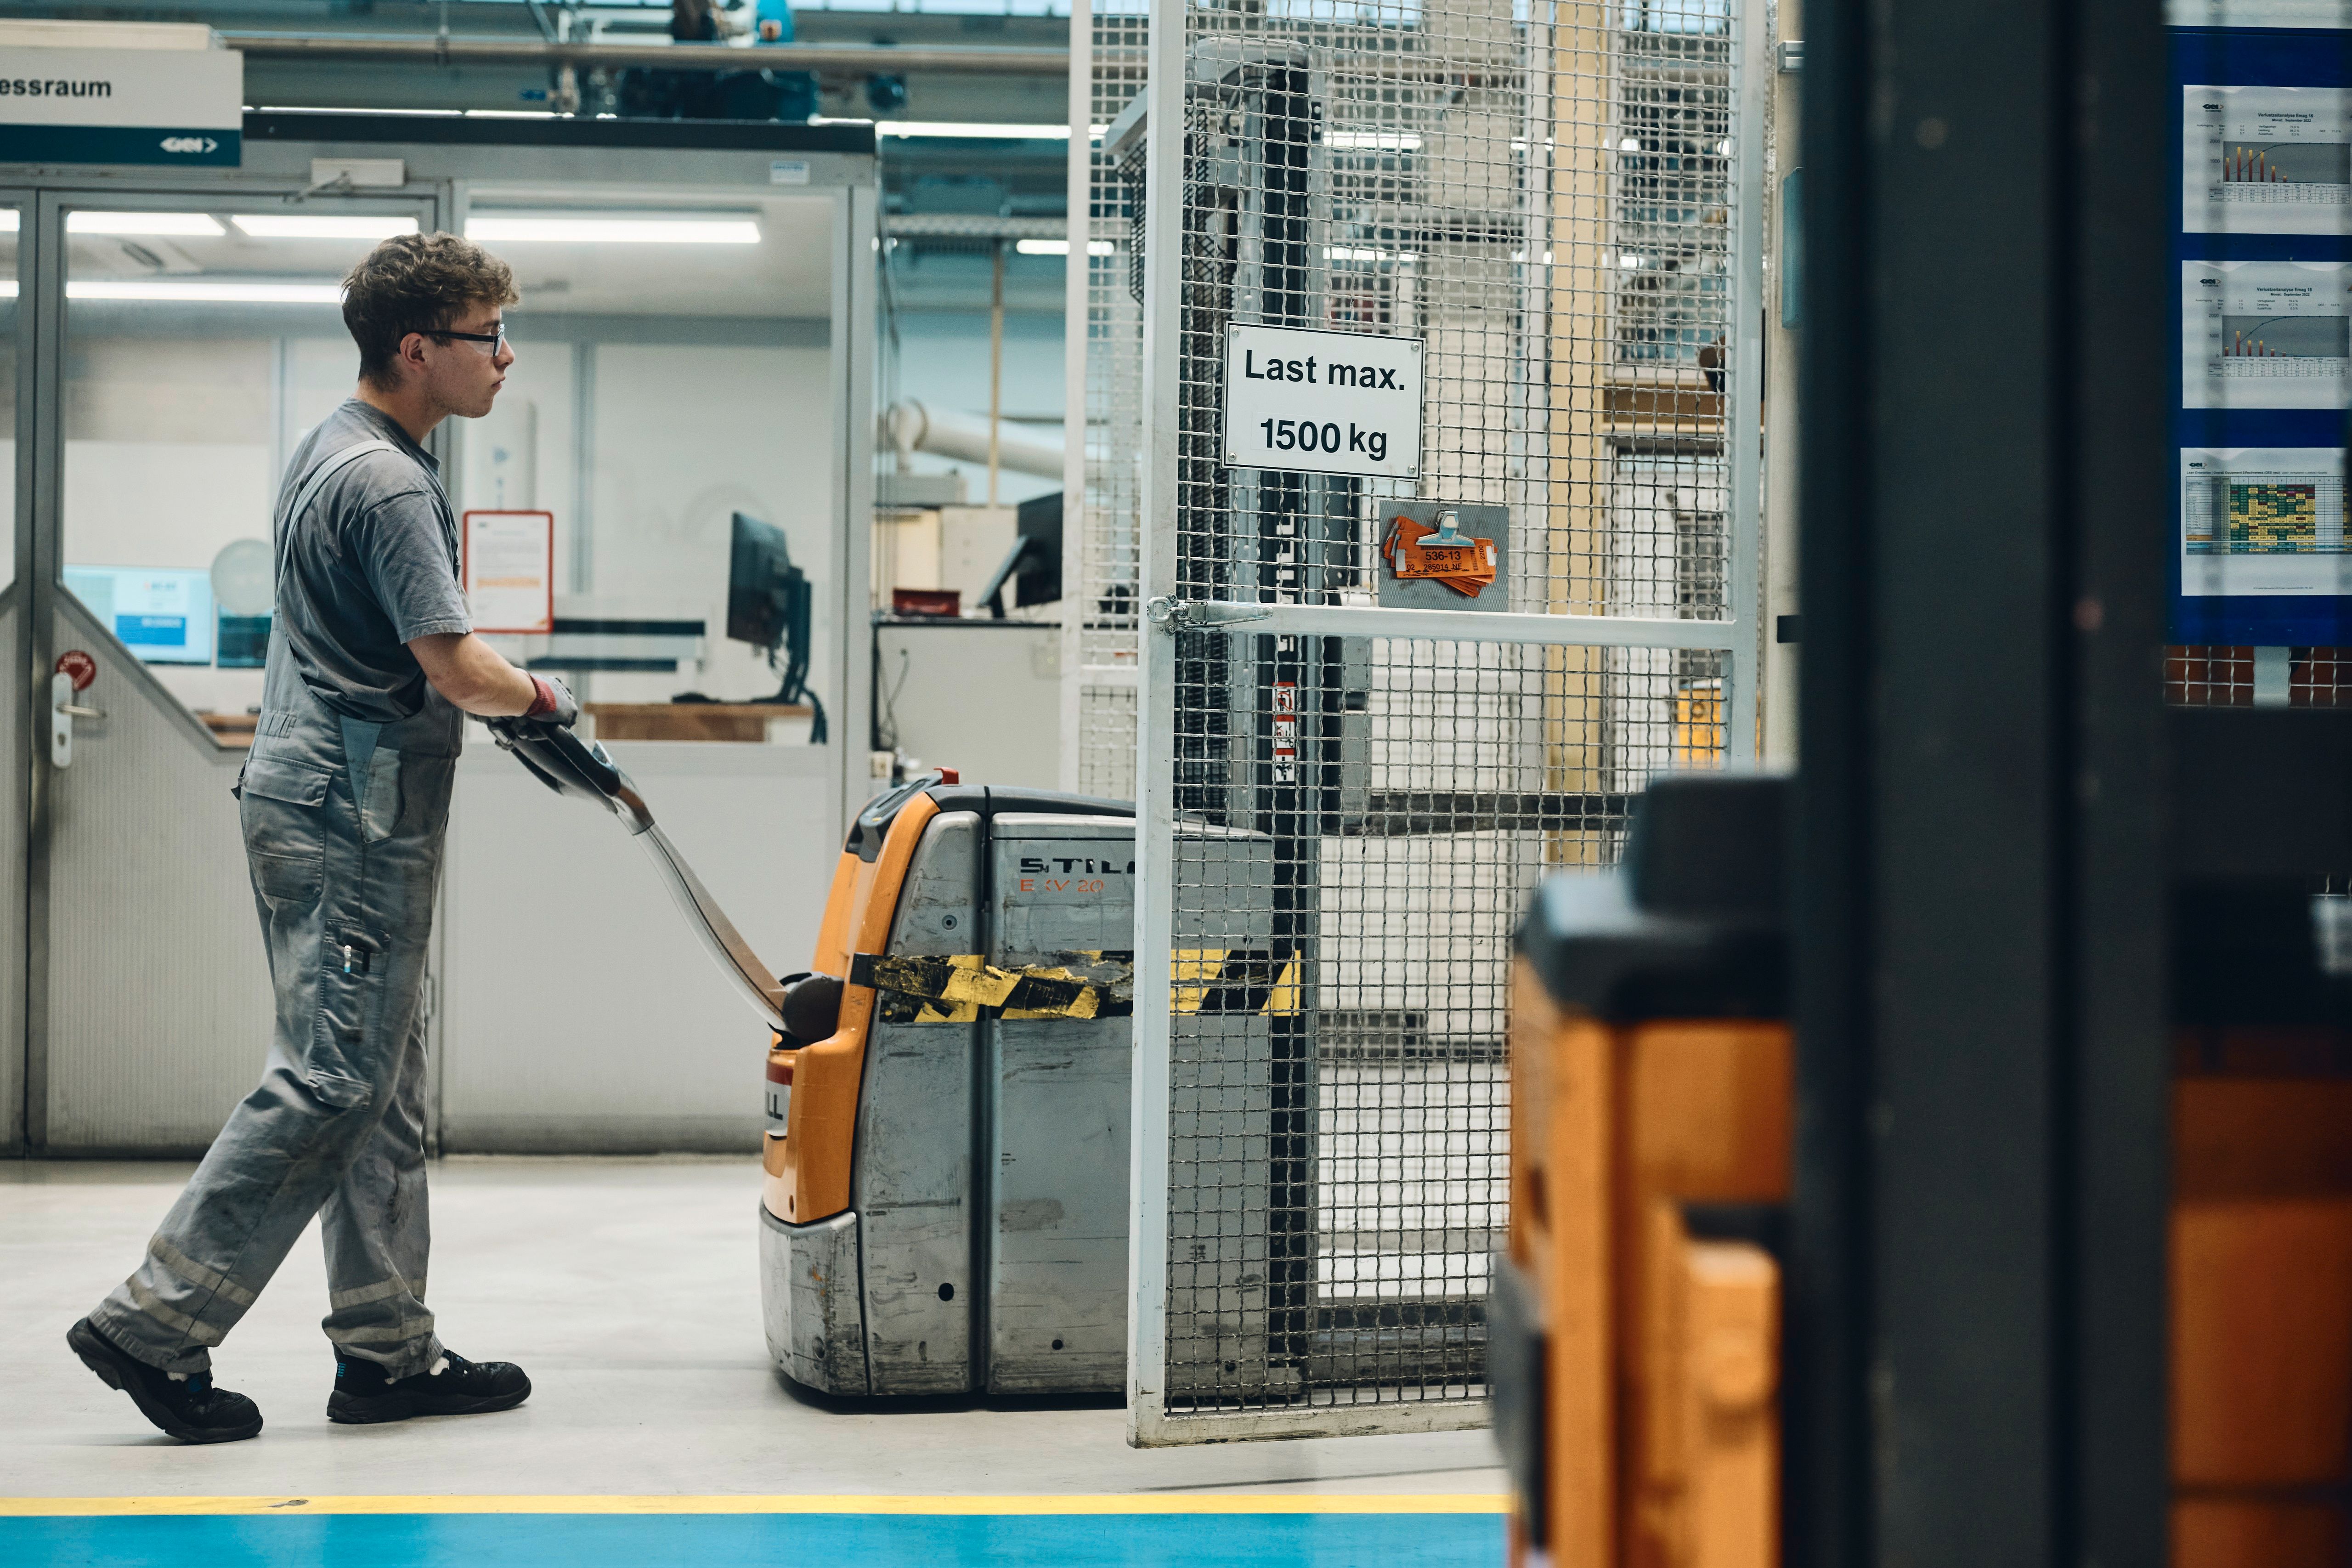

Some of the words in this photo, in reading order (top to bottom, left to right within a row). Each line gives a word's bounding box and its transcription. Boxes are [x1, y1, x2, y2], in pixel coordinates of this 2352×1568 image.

[1246, 349, 1317, 384] Last
[1328, 363, 1405, 391] max.
[1260, 419, 1340, 453] 1500
[1349, 423, 1387, 461] kg
[1425, 551, 1461, 560] 536-13
[1077, 879, 1104, 892] 20
